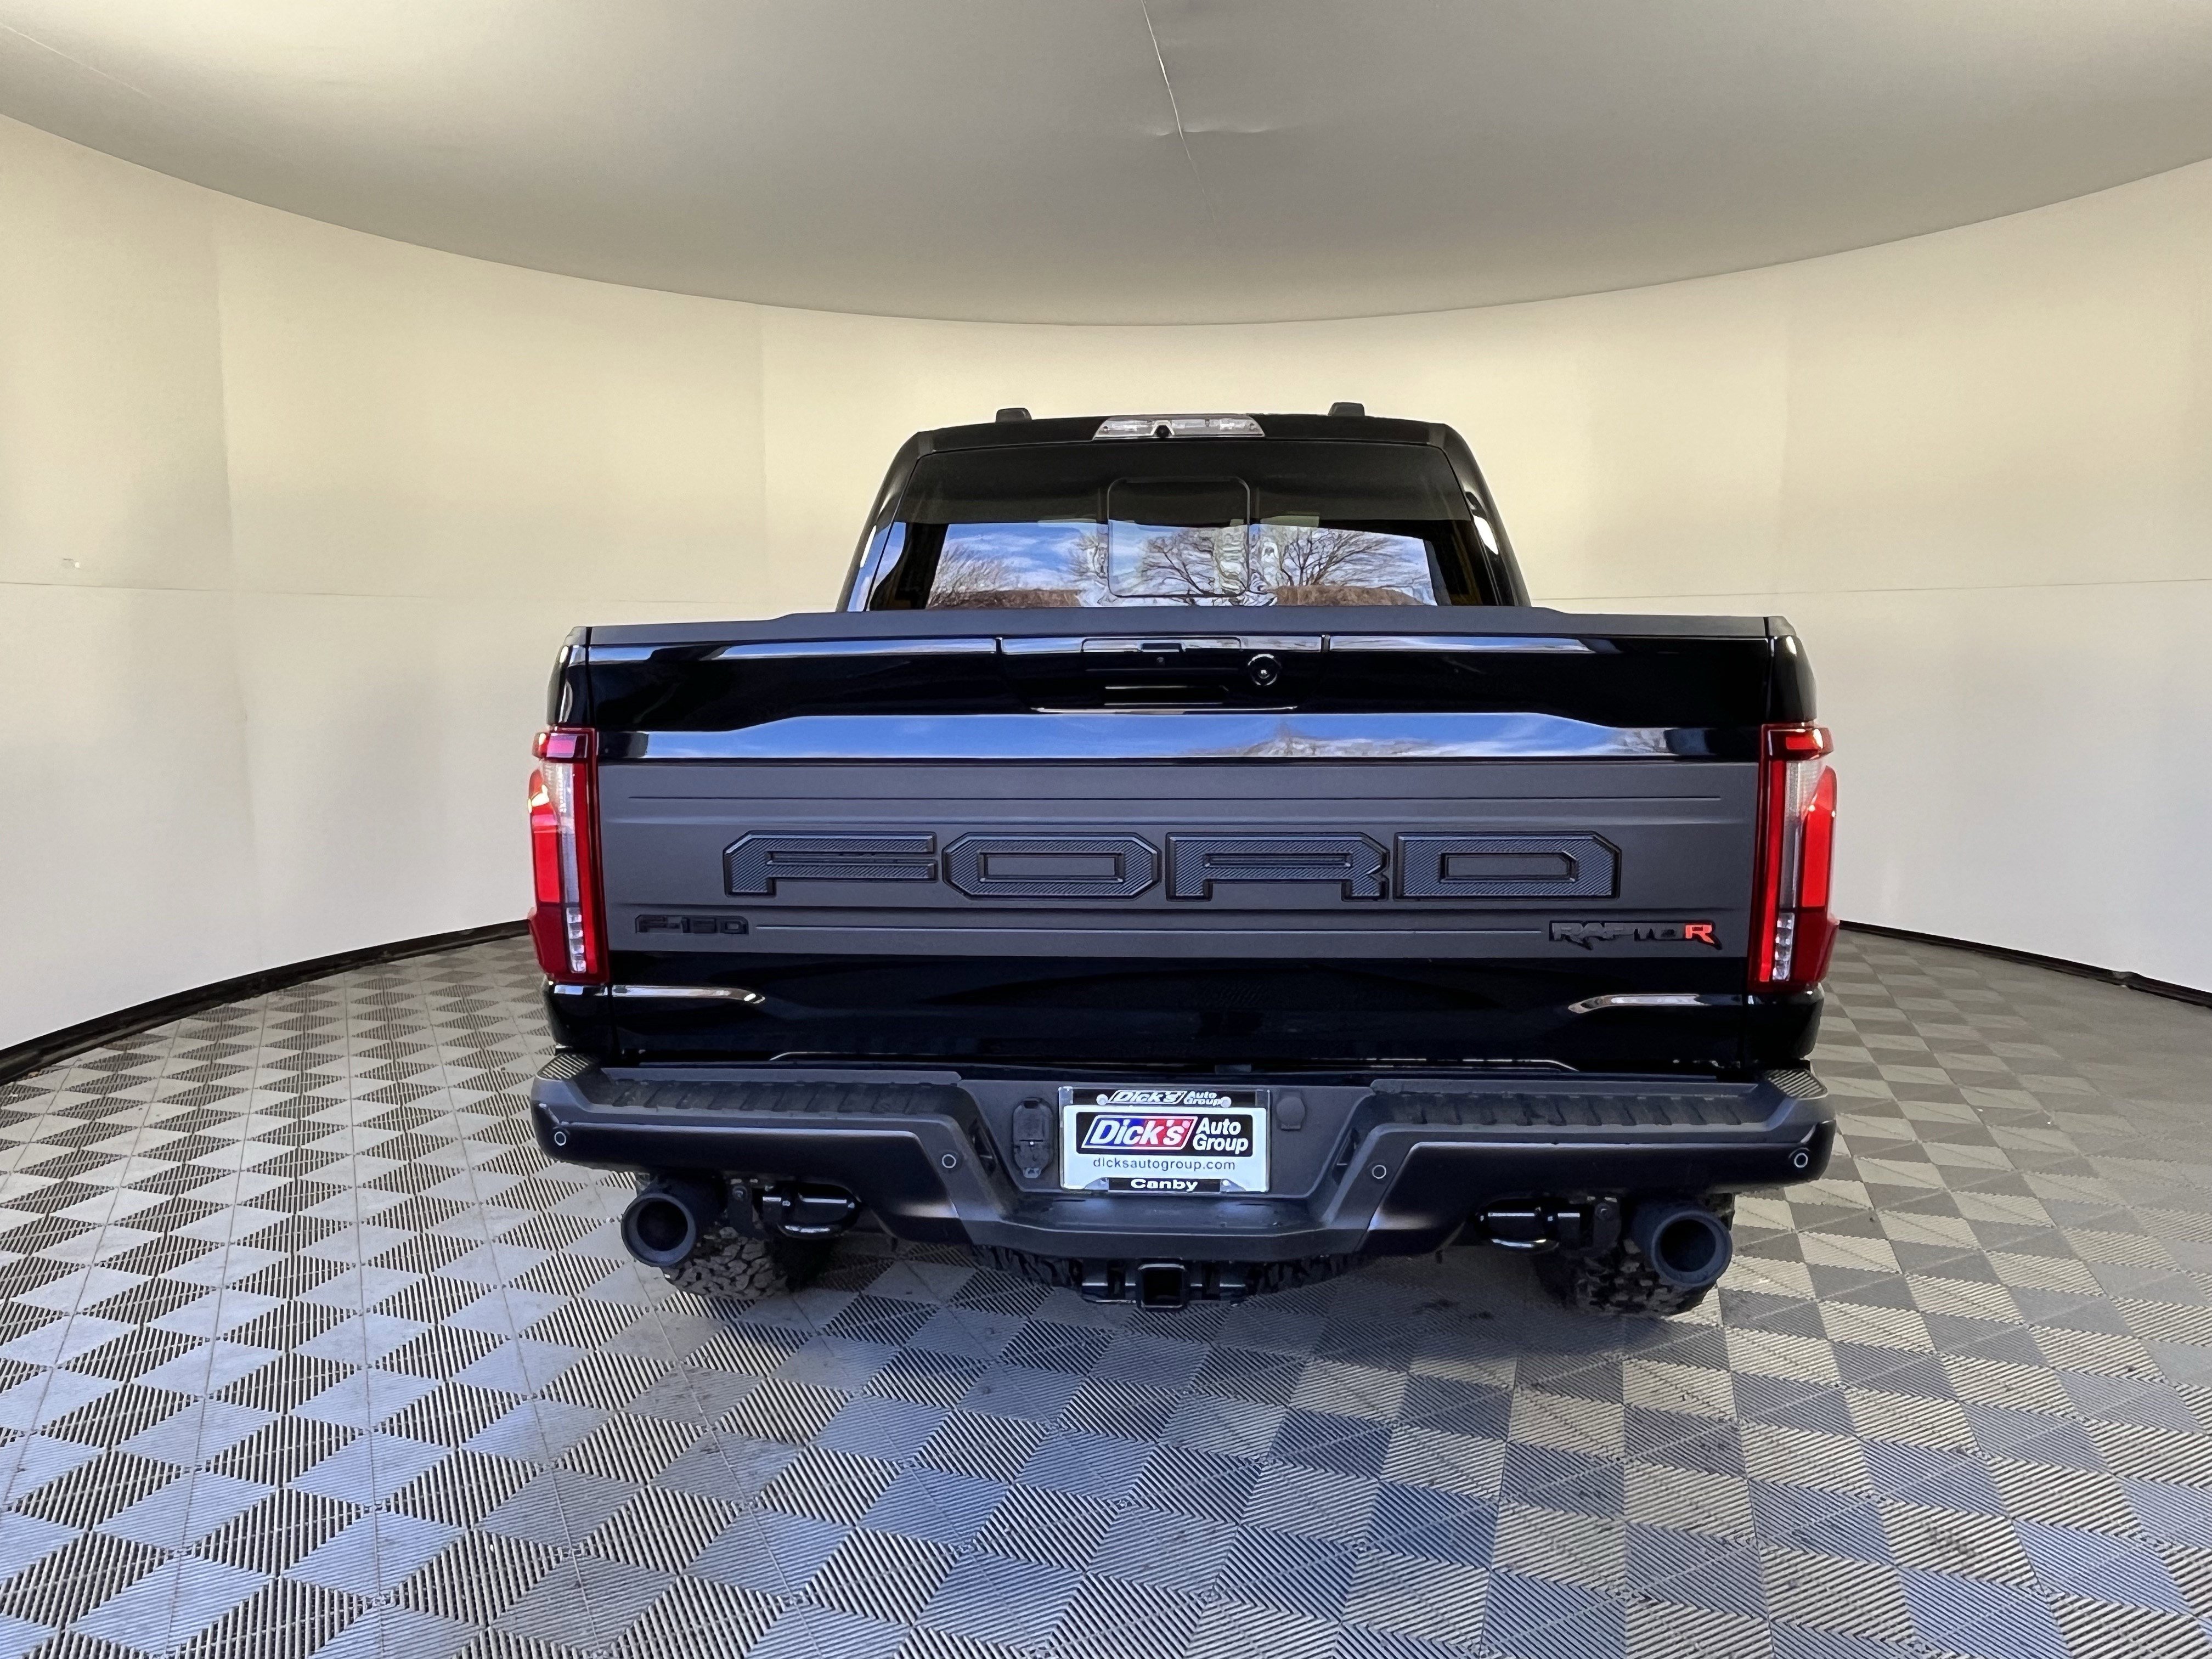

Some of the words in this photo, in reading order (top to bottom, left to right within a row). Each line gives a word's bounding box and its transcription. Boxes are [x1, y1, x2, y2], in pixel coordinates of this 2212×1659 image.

[723, 830, 1622, 901] FORD
[635, 915, 749, 935] F-150
[1114, 1091, 1180, 1103] Dick's
[1188, 1091, 1217, 1099] Auto
[1183, 1097, 1221, 1107] Group
[1090, 1119, 1186, 1146] Dick's
[1195, 1118, 1242, 1136] Auto
[1192, 1134, 1249, 1154] Group
[1093, 1157, 1235, 1171] dicksautogroup.com
[1130, 1178, 1198, 1192] Canby
